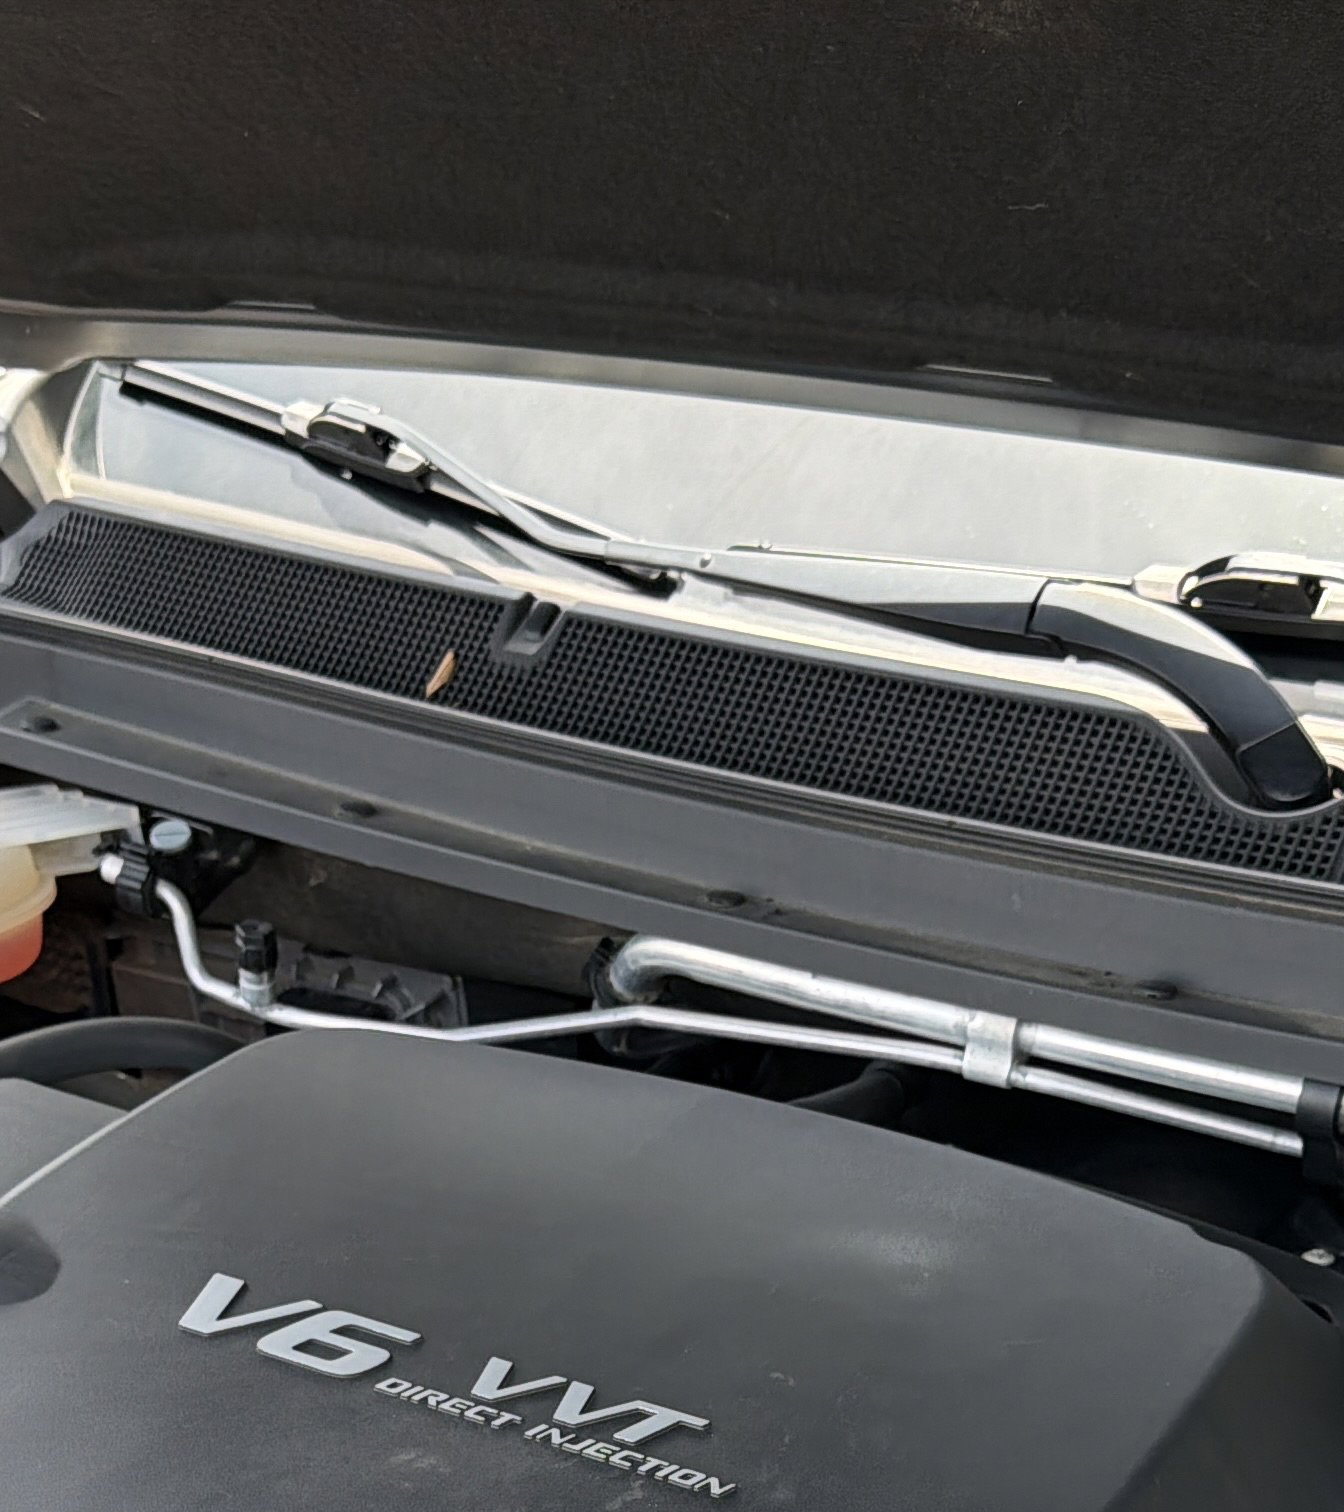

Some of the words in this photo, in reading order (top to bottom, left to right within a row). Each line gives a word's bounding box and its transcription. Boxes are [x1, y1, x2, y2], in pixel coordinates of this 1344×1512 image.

[179, 1273, 422, 1378] V6
[374, 1377, 522, 1428] DIRECT
[524, 1425, 736, 1497] INJECTION
[471, 1357, 709, 1444] VVT
